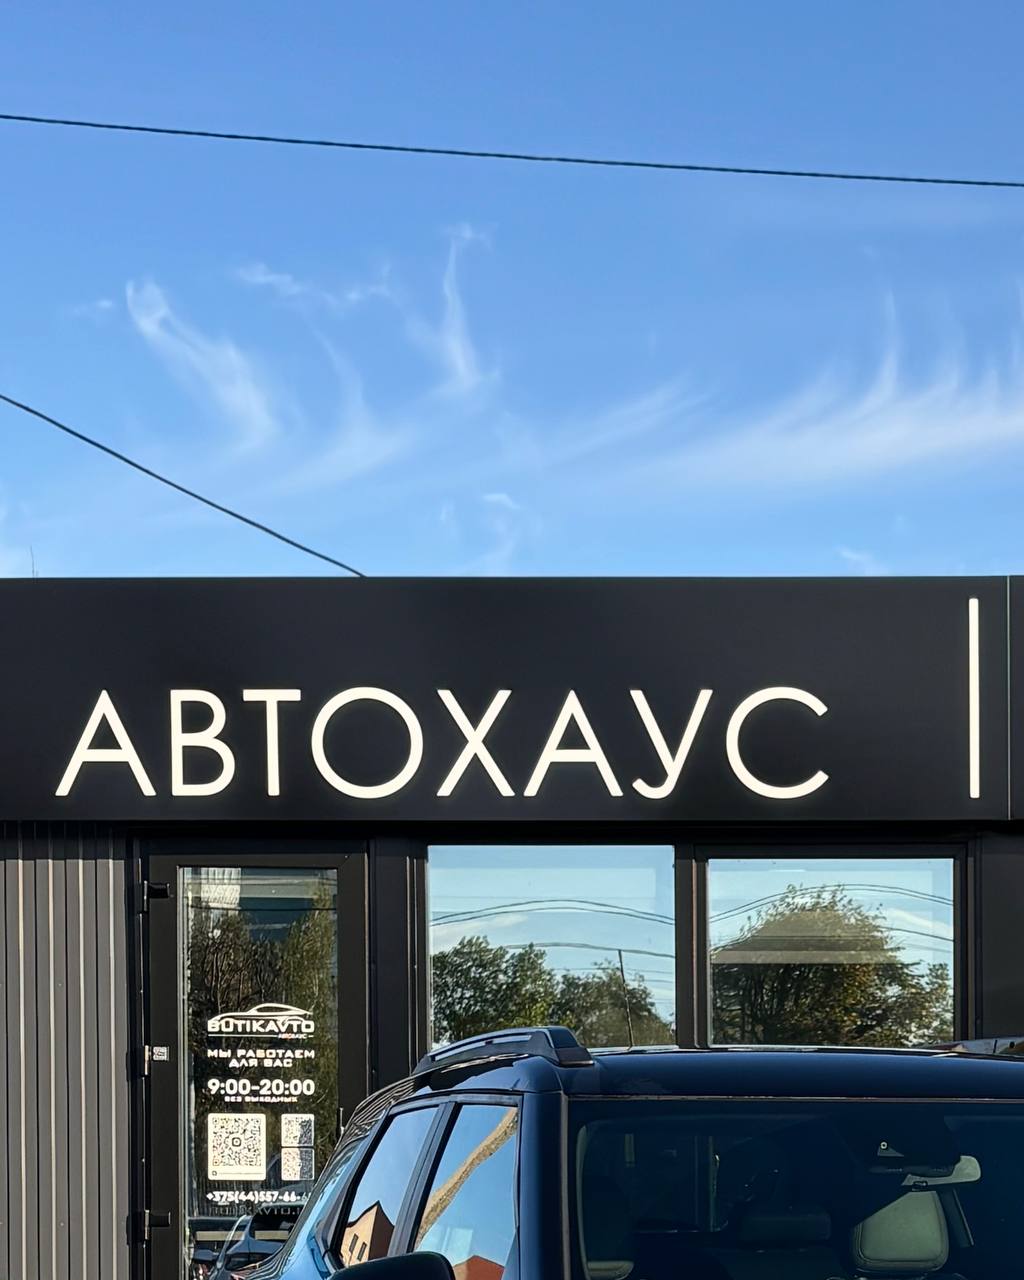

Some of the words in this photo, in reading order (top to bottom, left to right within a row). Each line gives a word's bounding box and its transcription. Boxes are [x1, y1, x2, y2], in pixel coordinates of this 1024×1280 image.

[54, 686, 831, 800] АВТОХАУС
[207, 1019, 315, 1033] BUTIKAVTO
[207, 1049, 231, 1058] МЫ
[236, 1049, 315, 1059] РАБОТАЕМ
[228, 1059, 258, 1068] ДЛЯ
[263, 1059, 293, 1068] ВАС
[207, 1078, 315, 1096] 9:00-20:00
